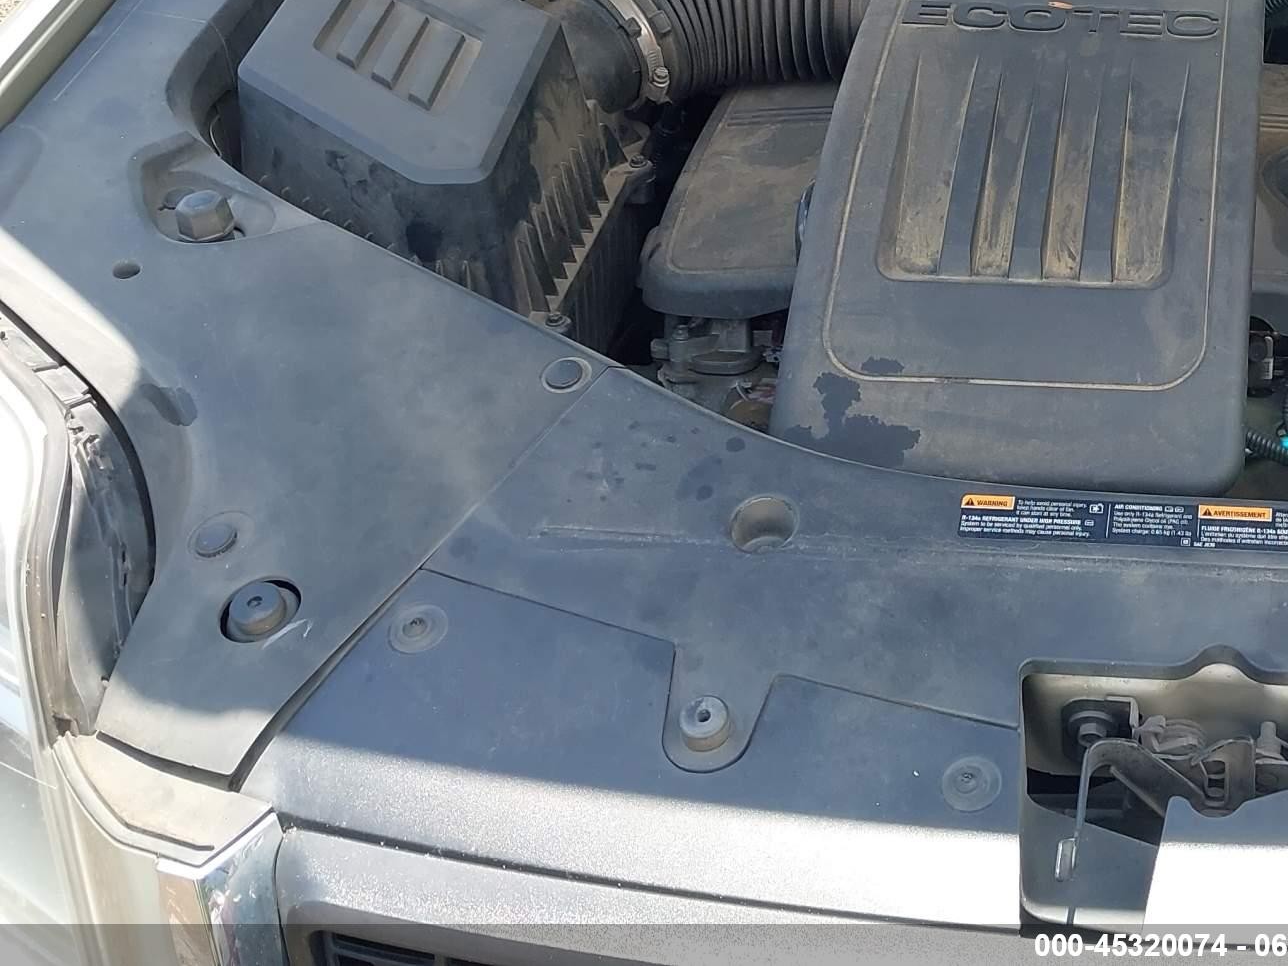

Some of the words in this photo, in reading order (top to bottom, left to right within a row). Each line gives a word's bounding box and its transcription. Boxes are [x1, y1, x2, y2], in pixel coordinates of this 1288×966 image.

[901, 0, 1219, 39] ECOTEC
[976, 499, 1008, 507] WARNING
[1213, 510, 1266, 518] AVERTISSEMENT
